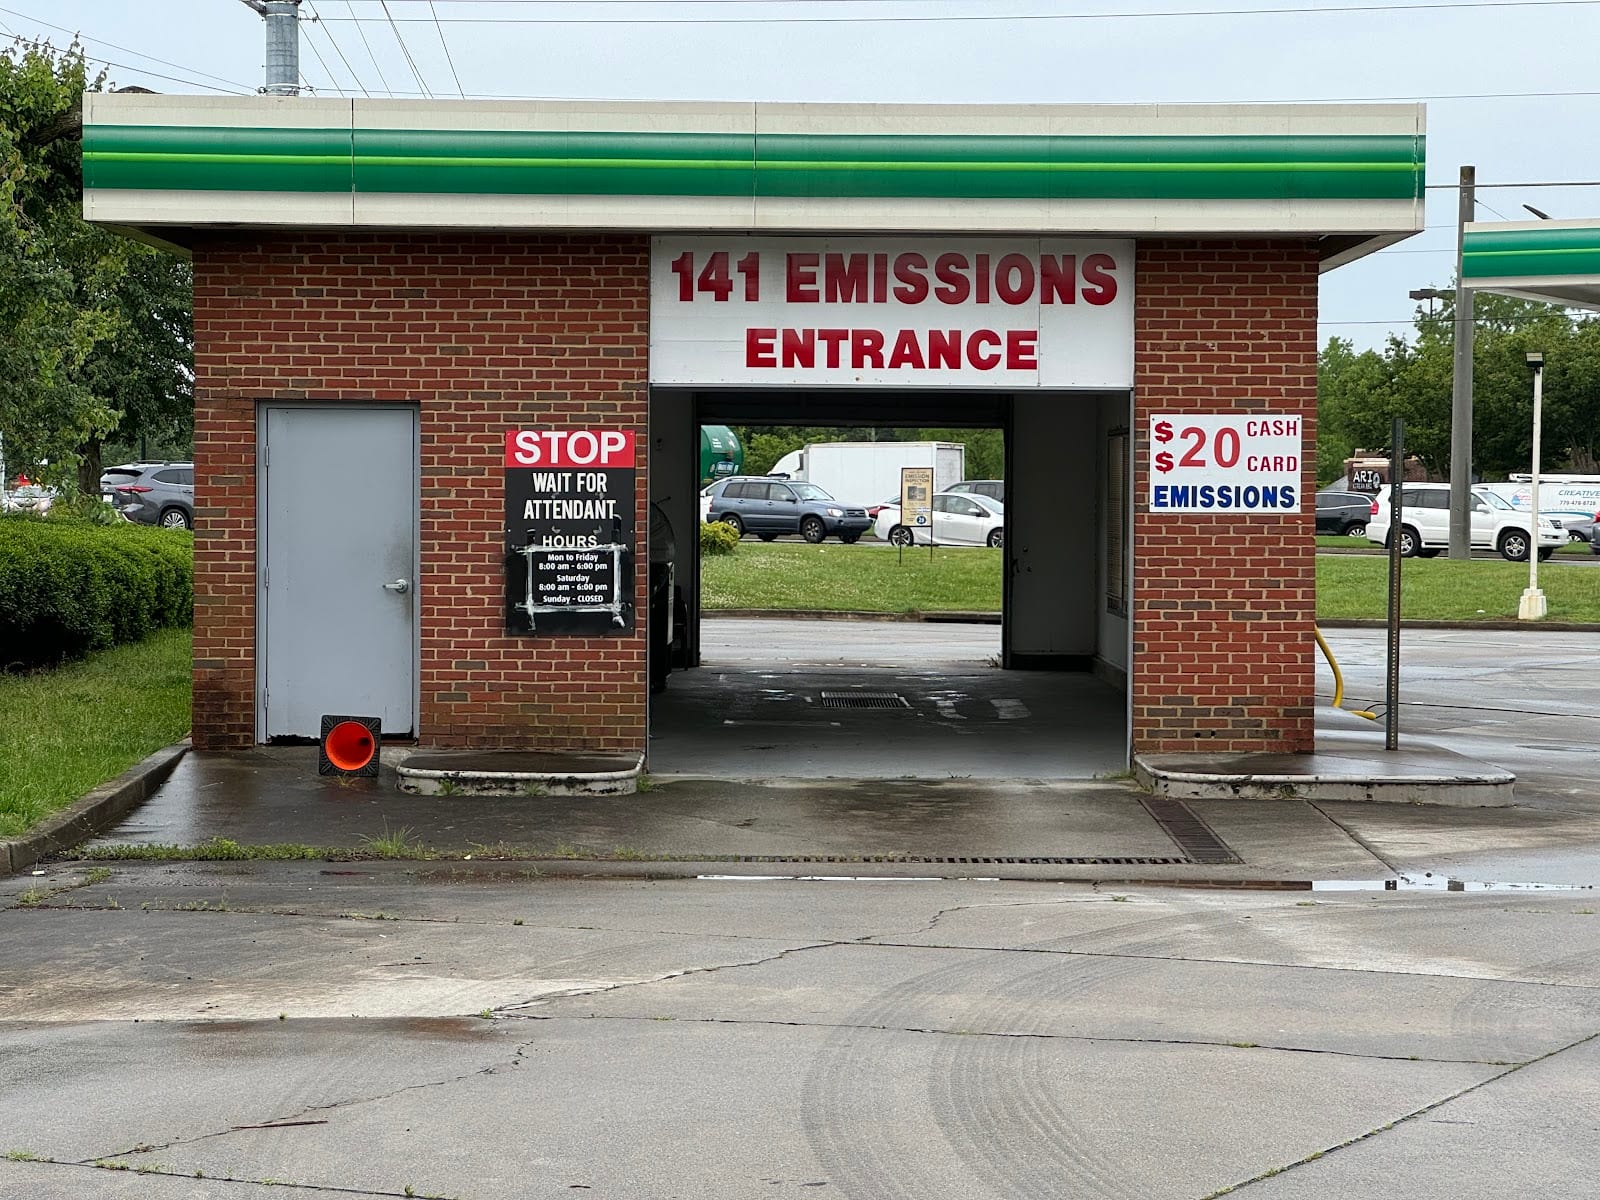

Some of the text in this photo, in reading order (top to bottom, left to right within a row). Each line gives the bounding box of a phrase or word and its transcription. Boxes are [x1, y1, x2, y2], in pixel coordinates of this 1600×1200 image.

[672, 251, 1118, 306] 141 EMISSIONS
[746, 328, 1038, 371] ENTRANCE
[514, 431, 626, 464] STOP
[1178, 426, 1241, 468] 20
[1246, 420, 1297, 437] CASH
[1247, 456, 1297, 472] CARD
[532, 472, 608, 493] WAIT FOR
[1154, 485, 1295, 508] EMISSIONS
[523, 499, 617, 520] ATTENDANT
[542, 535, 598, 548] HOURS
[547, 553, 564, 561] Mon
[575, 553, 599, 562] Friday
[594, 563, 608, 571] pm
[538, 583, 555, 591] 8:00
[576, 583, 593, 591] 6:00
[594, 584, 608, 592] pm
[556, 574, 590, 583] Saturday
[543, 595, 571, 604] Sunday
